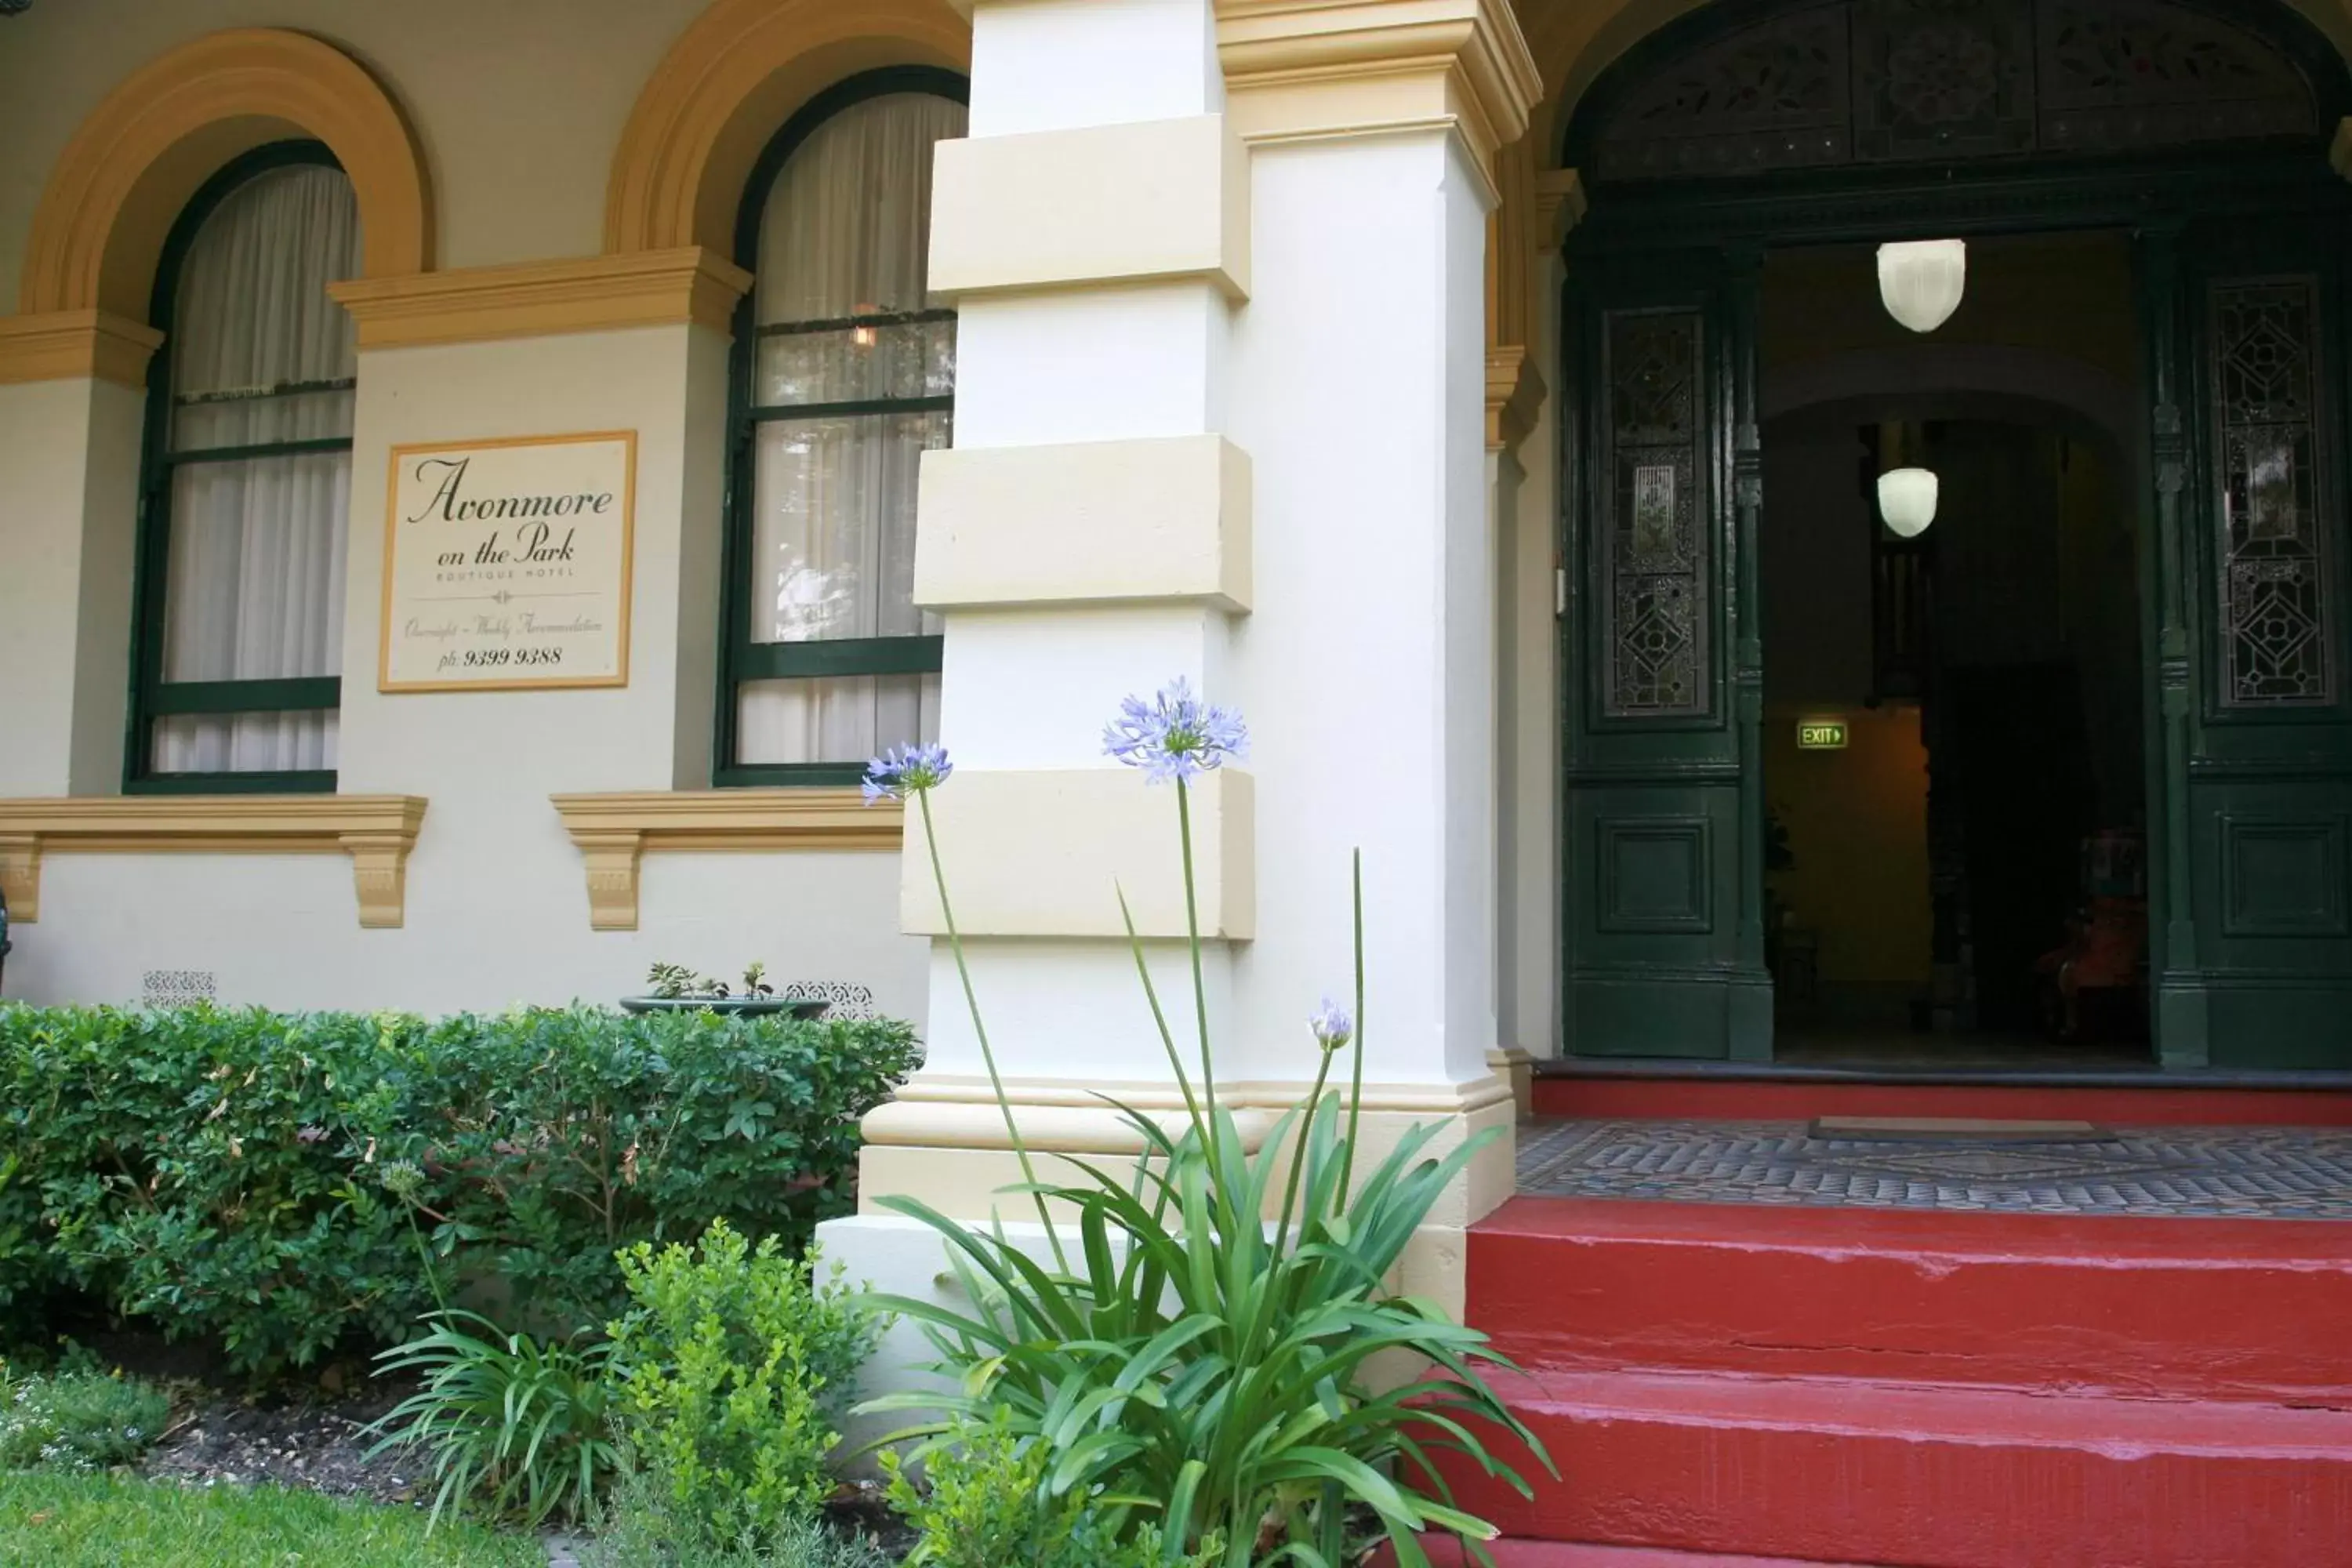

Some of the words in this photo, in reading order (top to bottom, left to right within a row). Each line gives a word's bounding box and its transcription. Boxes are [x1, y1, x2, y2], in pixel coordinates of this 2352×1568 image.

[407, 455, 613, 524] Avonmore
[437, 551, 465, 566] on
[474, 530, 510, 564] the
[514, 521, 575, 564] Park
[436, 569, 514, 582] BOUTIQUE
[526, 567, 574, 578] HOTEL
[463, 648, 510, 667] 9399
[514, 646, 563, 666] 9388
[1803, 728, 1832, 744] EXIT
